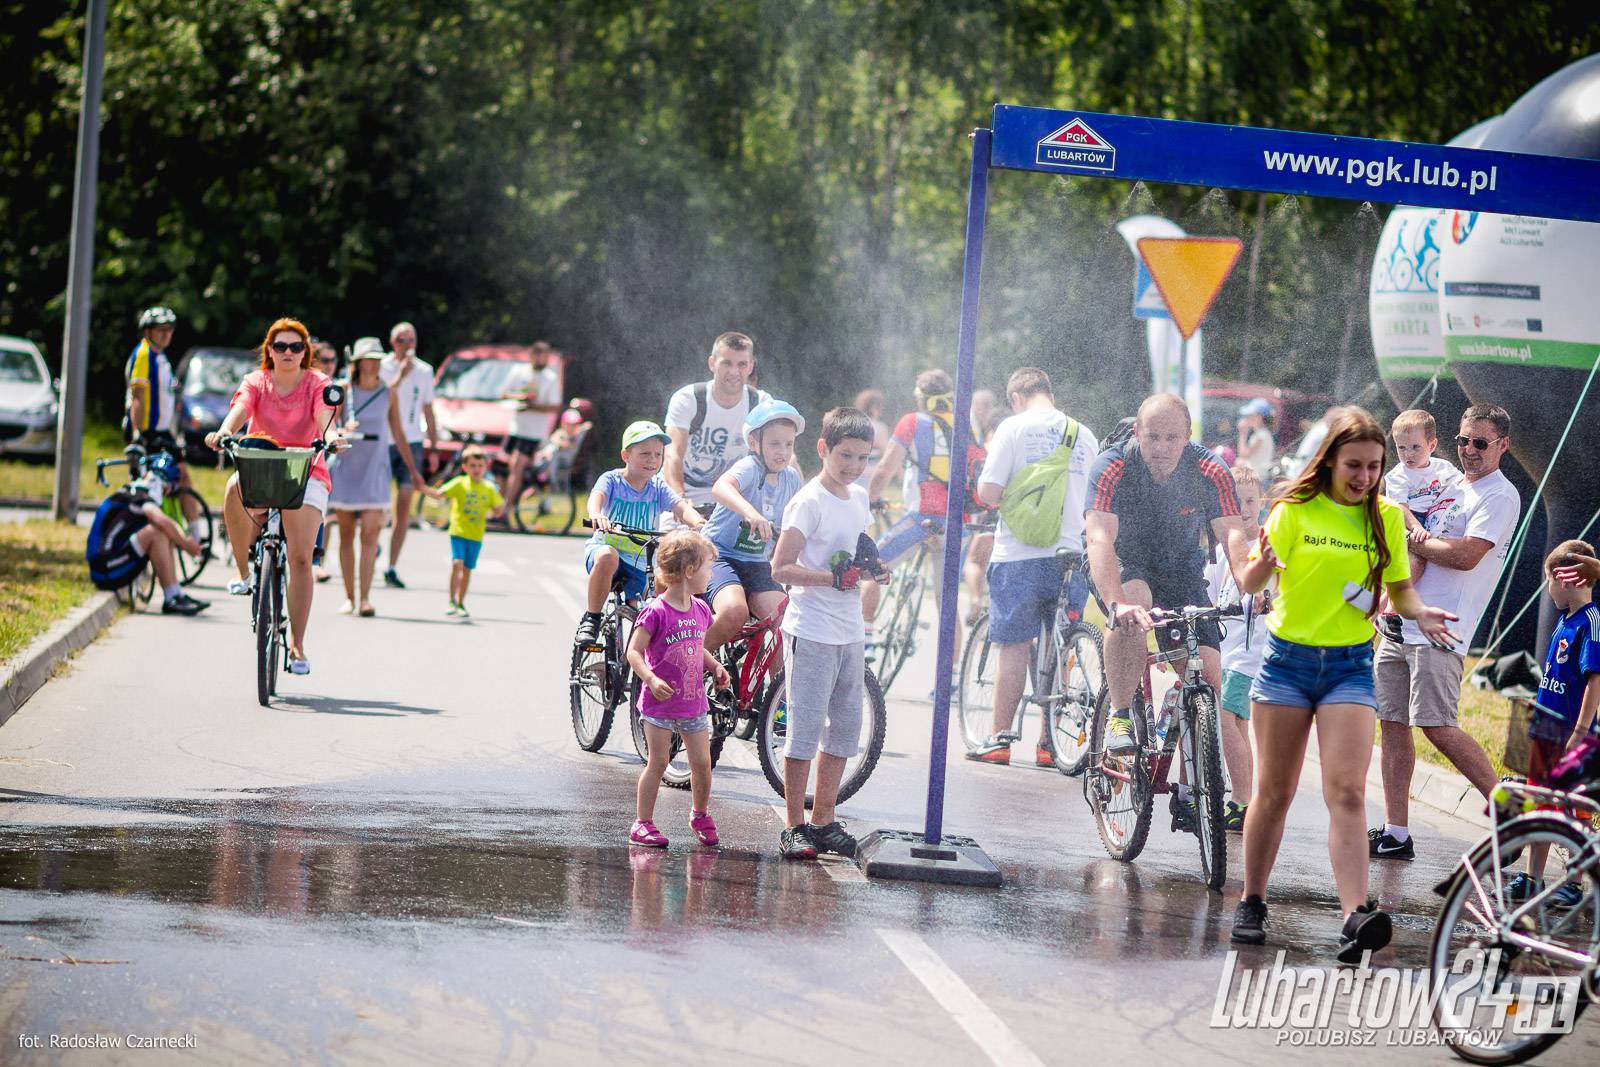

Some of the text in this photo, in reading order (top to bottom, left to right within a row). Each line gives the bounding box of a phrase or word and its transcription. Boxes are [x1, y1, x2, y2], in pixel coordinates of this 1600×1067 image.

[1066, 132, 1088, 144] PGK
[1047, 150, 1106, 163] LUBARTÓW
[1263, 150, 1498, 195] www.pgk.lub.pl
[1304, 534, 1376, 553] Rajd Rowerow
[1540, 677, 1567, 695] ates
